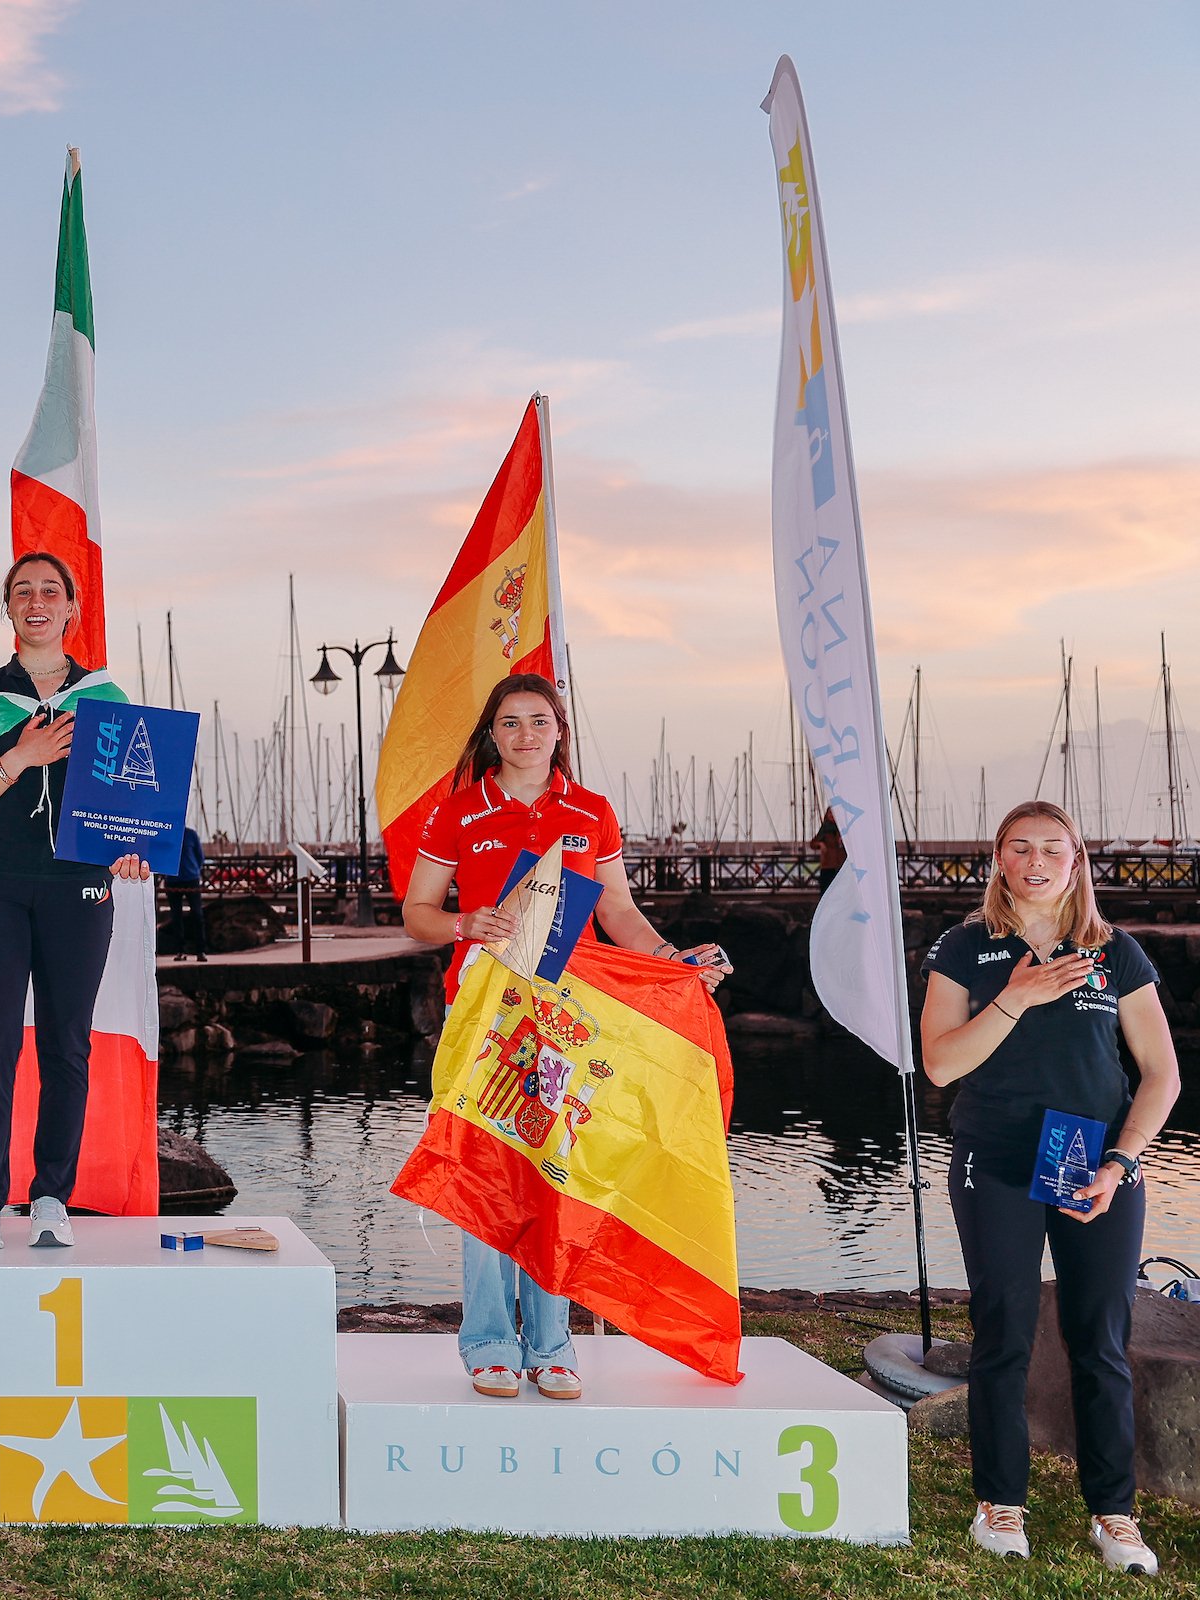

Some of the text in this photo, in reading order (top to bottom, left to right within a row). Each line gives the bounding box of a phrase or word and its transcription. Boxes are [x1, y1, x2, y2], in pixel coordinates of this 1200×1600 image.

[91, 721, 122, 787] ILCA
[72, 810, 87, 818] 2026
[87, 812, 103, 821] ILCA
[108, 815, 140, 826] WOMEN'S
[140, 820, 173, 830] UNDER-21
[83, 821, 159, 837] WORLD CHAMPIONSHIP
[114, 834, 136, 843] PLACE
[562, 835, 587, 848] ESP
[82, 887, 104, 900] FIV
[524, 879, 557, 897] ILCA
[977, 949, 1012, 965] SLAM
[1045, 1127, 1066, 1169] ILCA
[964, 1151, 975, 1189] ITA
[38, 1277, 83, 1387] 1
[385, 1442, 743, 1477] RUBICÓN
[777, 1424, 840, 1532] 3
